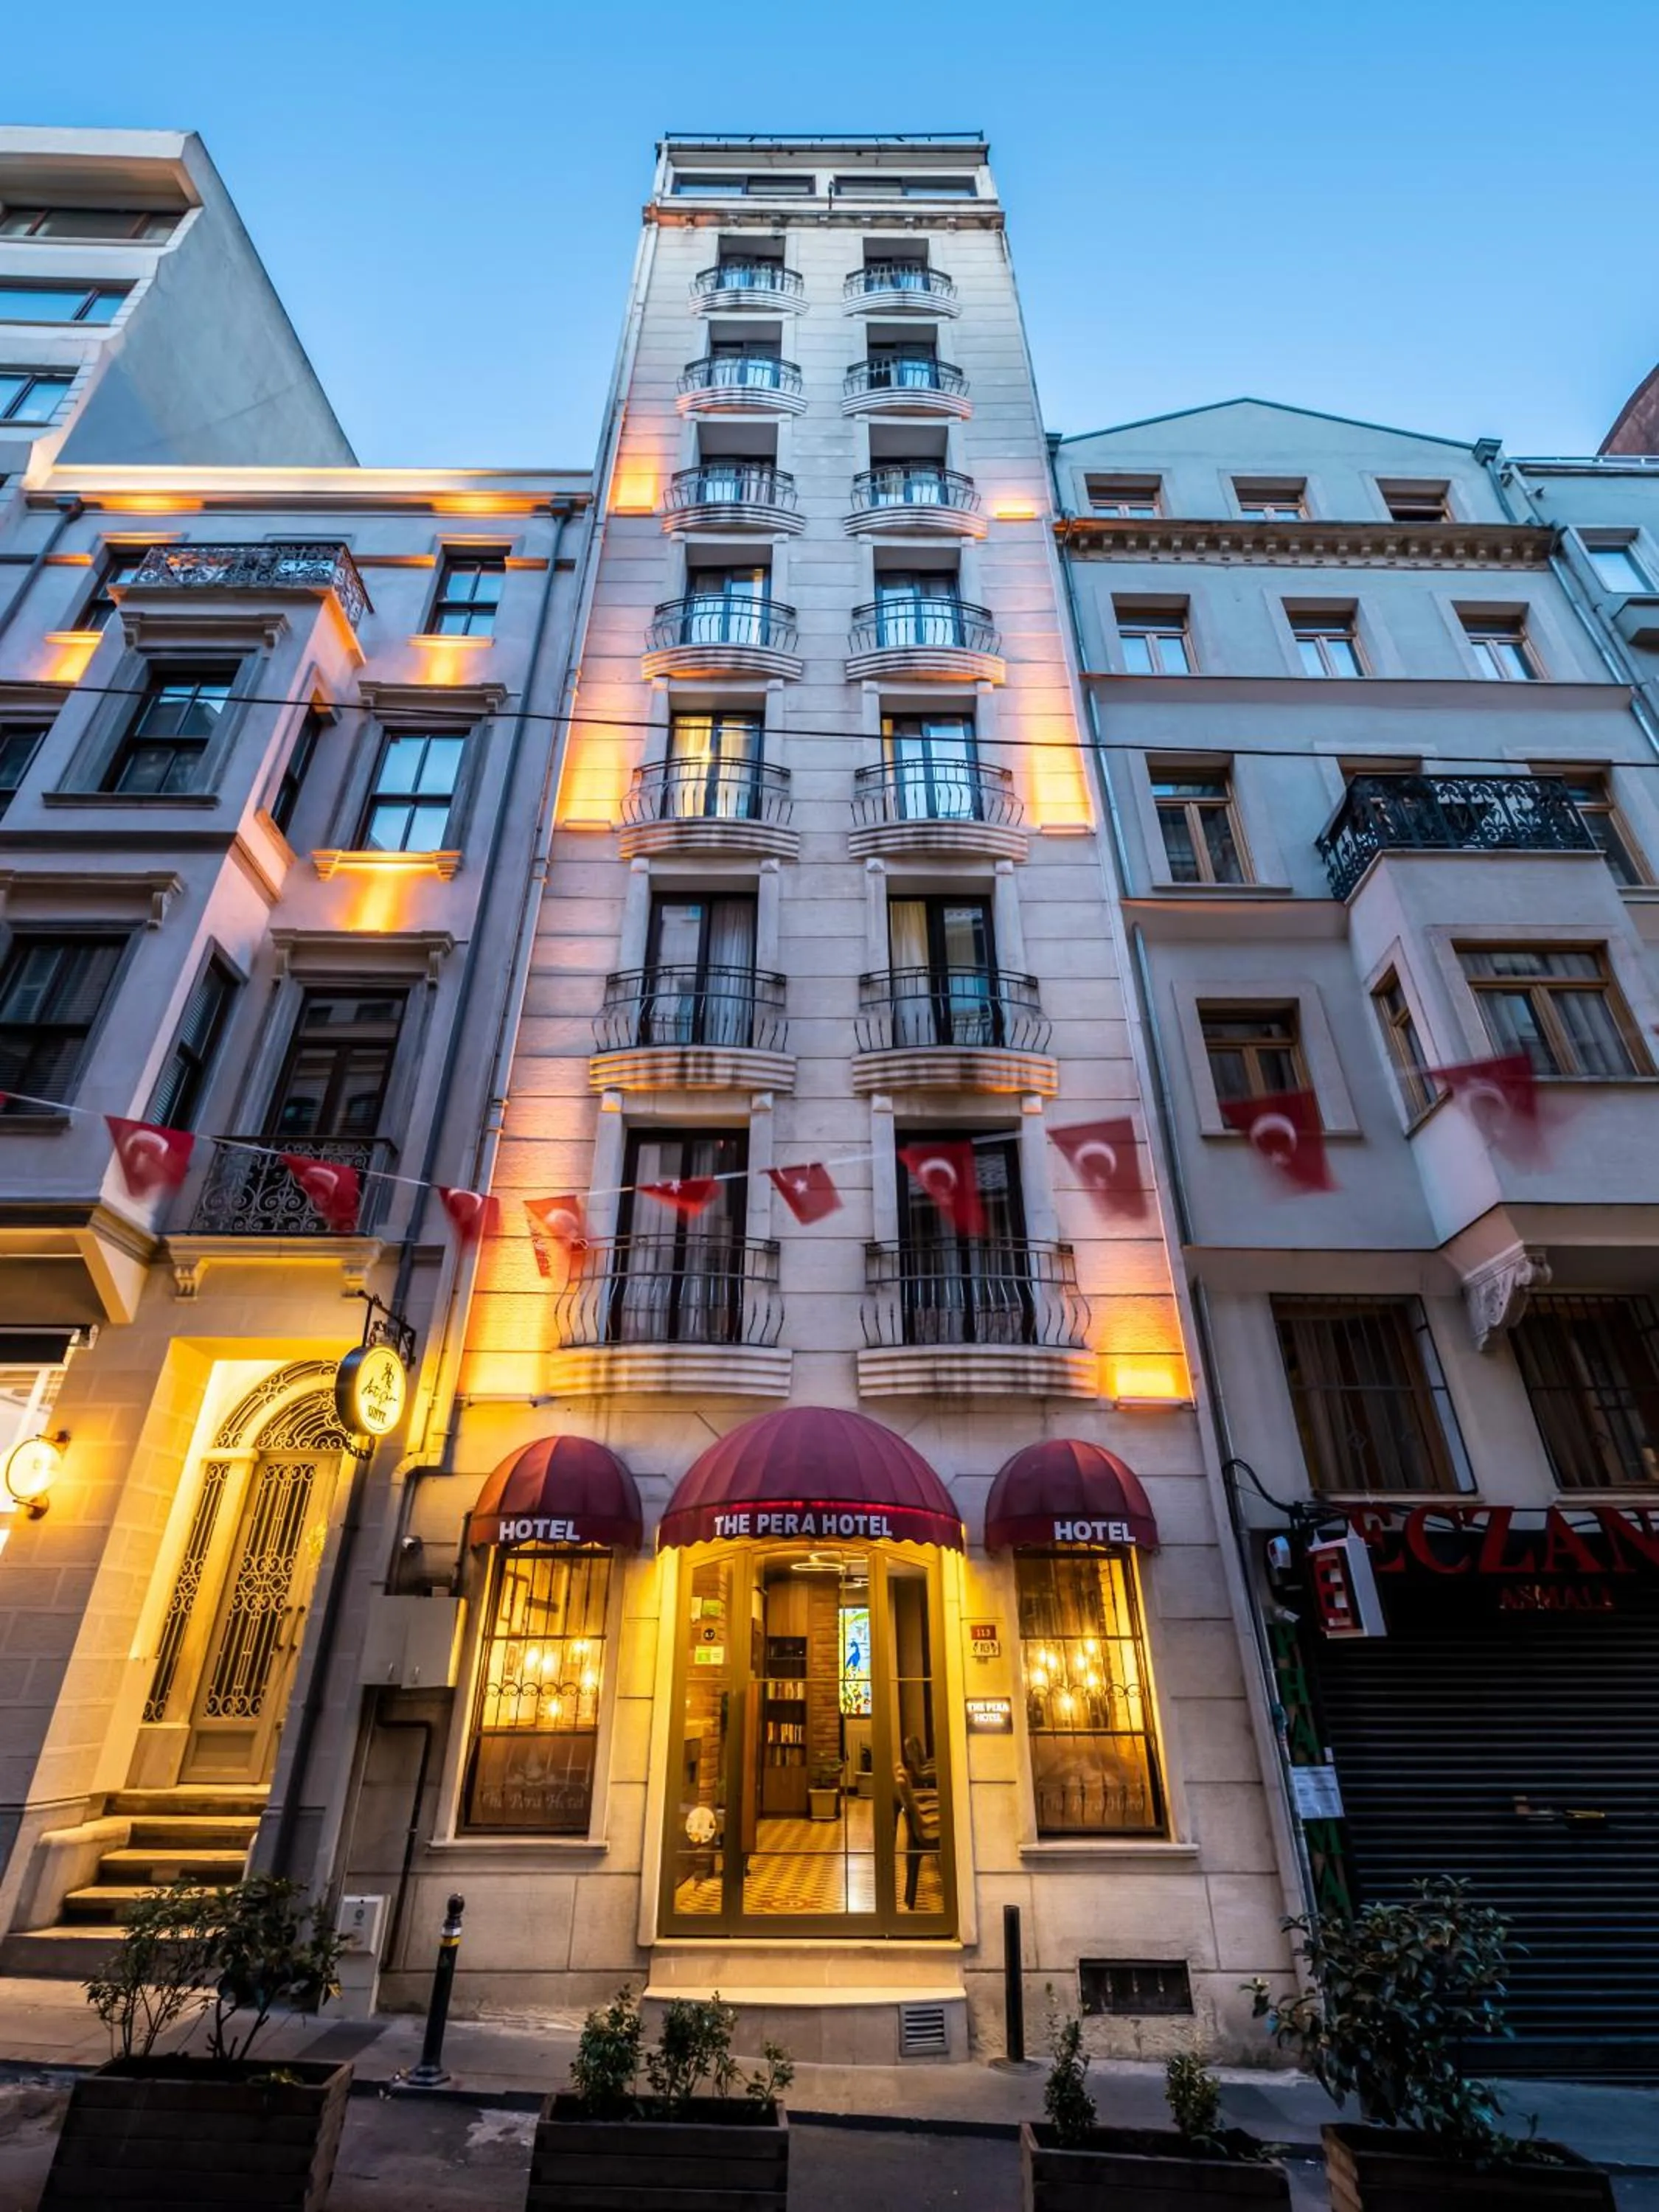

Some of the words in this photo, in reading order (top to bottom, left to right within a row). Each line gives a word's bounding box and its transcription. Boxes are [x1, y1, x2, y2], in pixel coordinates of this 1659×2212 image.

[499, 1519, 580, 1541] HOTEL
[714, 1514, 750, 1536] THE
[757, 1513, 816, 1534] PERA
[822, 1514, 893, 1537] HOTEL
[1053, 1520, 1136, 1543] HOTEL
